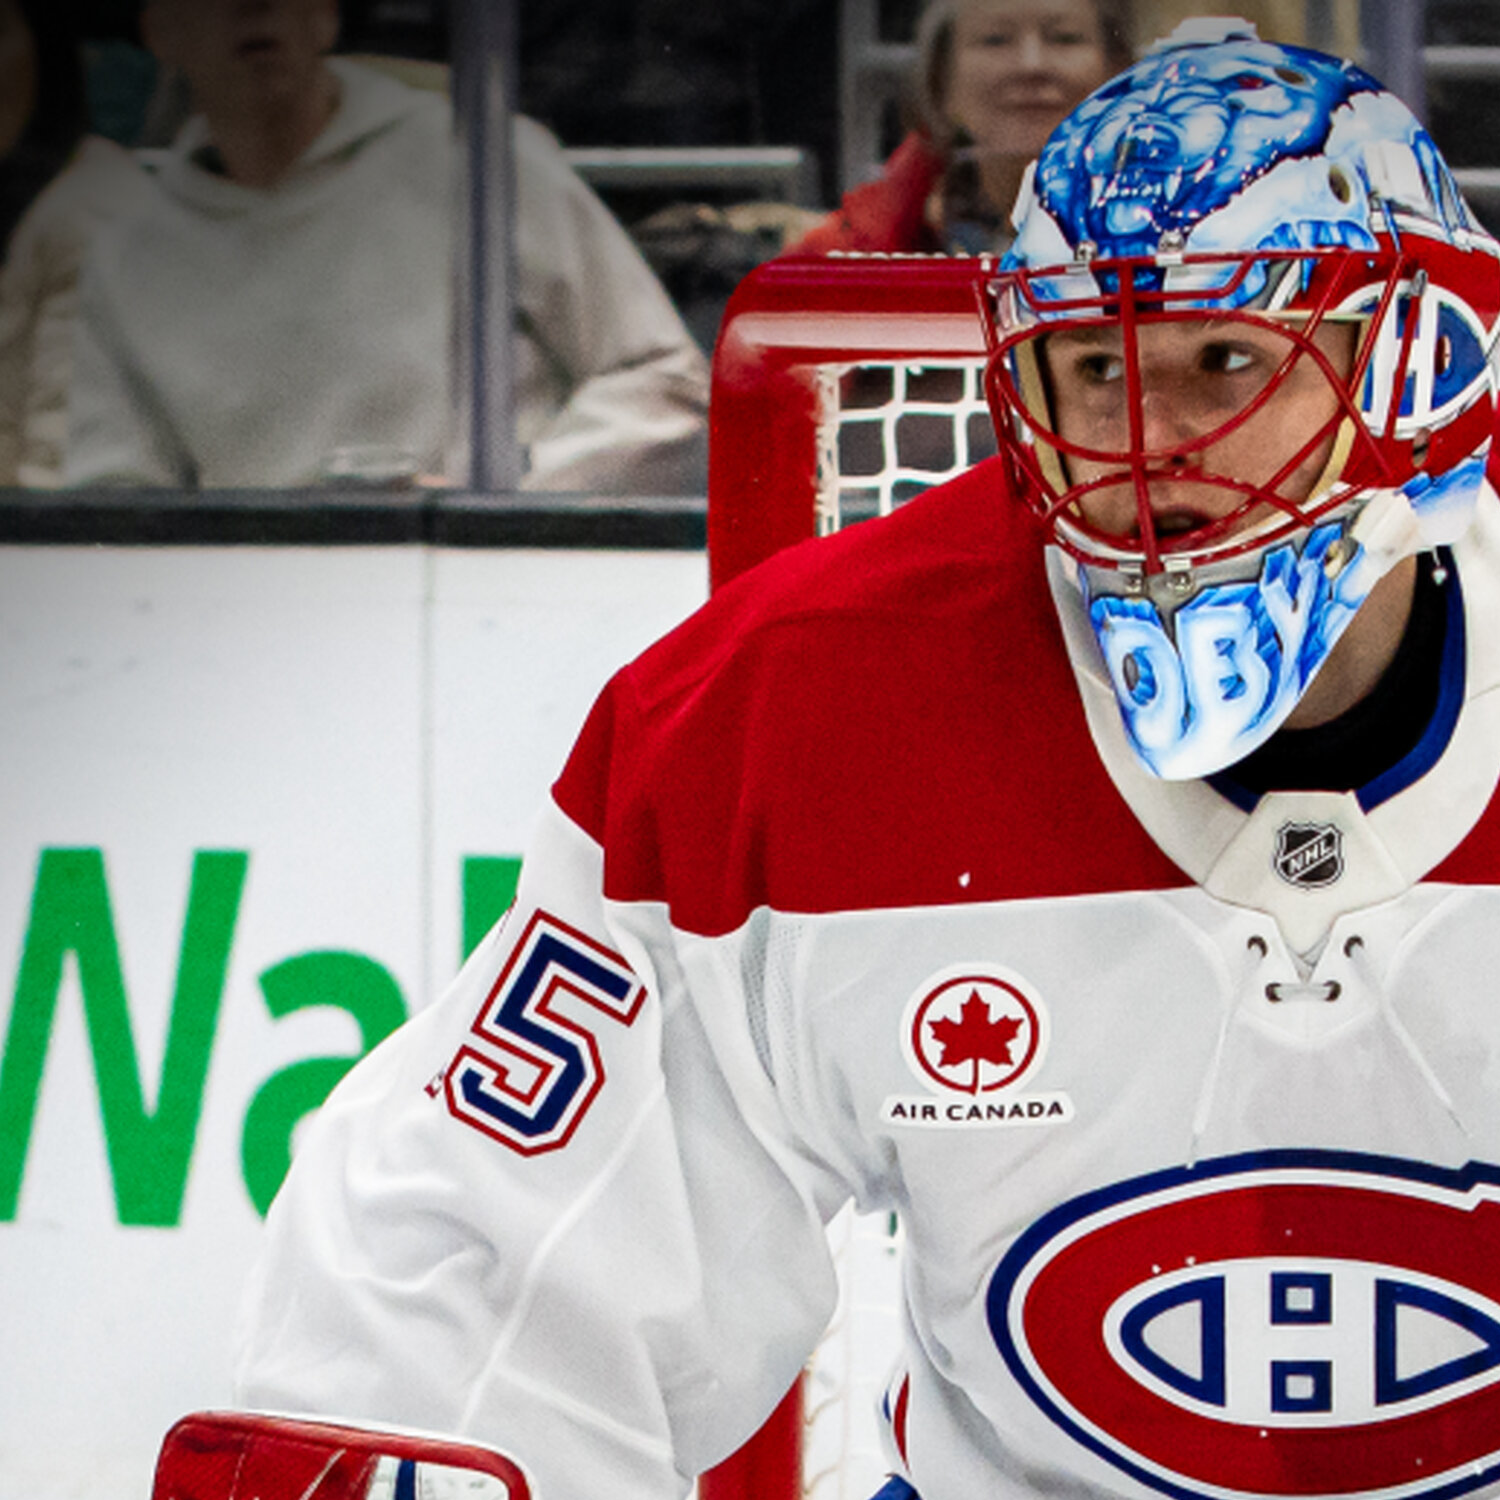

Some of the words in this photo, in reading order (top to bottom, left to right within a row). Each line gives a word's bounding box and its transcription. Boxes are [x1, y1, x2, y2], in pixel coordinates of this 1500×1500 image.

[1288, 838, 1335, 875] NHL
[0, 846, 520, 1227] Wa
[424, 908, 648, 1158] 5
[890, 1102, 938, 1121] AIR
[945, 1100, 1065, 1121] CANADA
